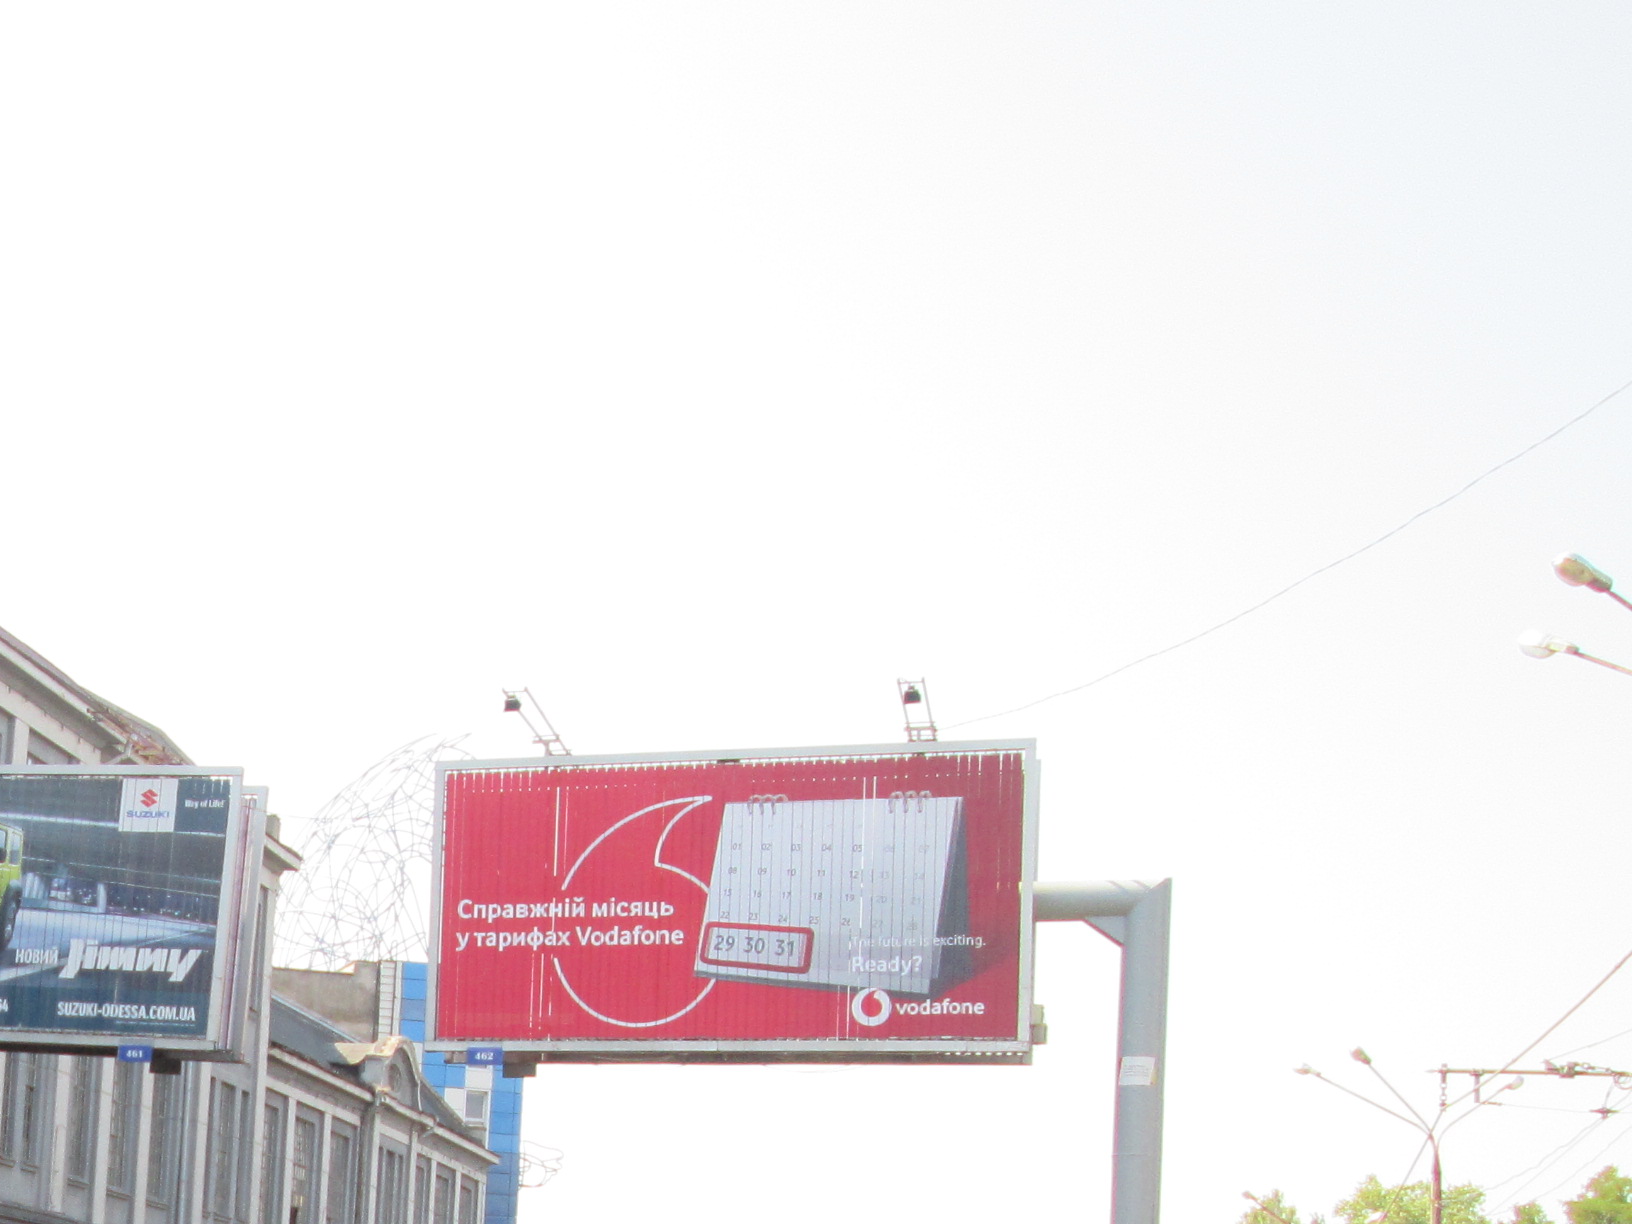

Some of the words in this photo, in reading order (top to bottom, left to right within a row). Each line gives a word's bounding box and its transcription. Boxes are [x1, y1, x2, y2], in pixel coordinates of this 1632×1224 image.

[126, 810, 170, 819] SUZUKI
[457, 897, 585, 923] Справжній
[591, 897, 675, 919] місяць
[455, 931, 469, 951] у
[473, 926, 571, 951] тарифах
[574, 925, 685, 946] Vodafone
[713, 934, 736, 952] 29
[742, 936, 766, 955] 30
[774, 939, 796, 957] 31
[932, 934, 987, 949] exciting.
[14, 946, 59, 965] НОВИЙ
[58, 938, 203, 982] Jimny
[851, 955, 923, 976] Ready?
[57, 1001, 196, 1022] SUZUKI-ODESSA.COM.UA
[895, 998, 985, 1016] vodafone
[126, 1049, 143, 1059] 461
[474, 1052, 494, 1061] 462
